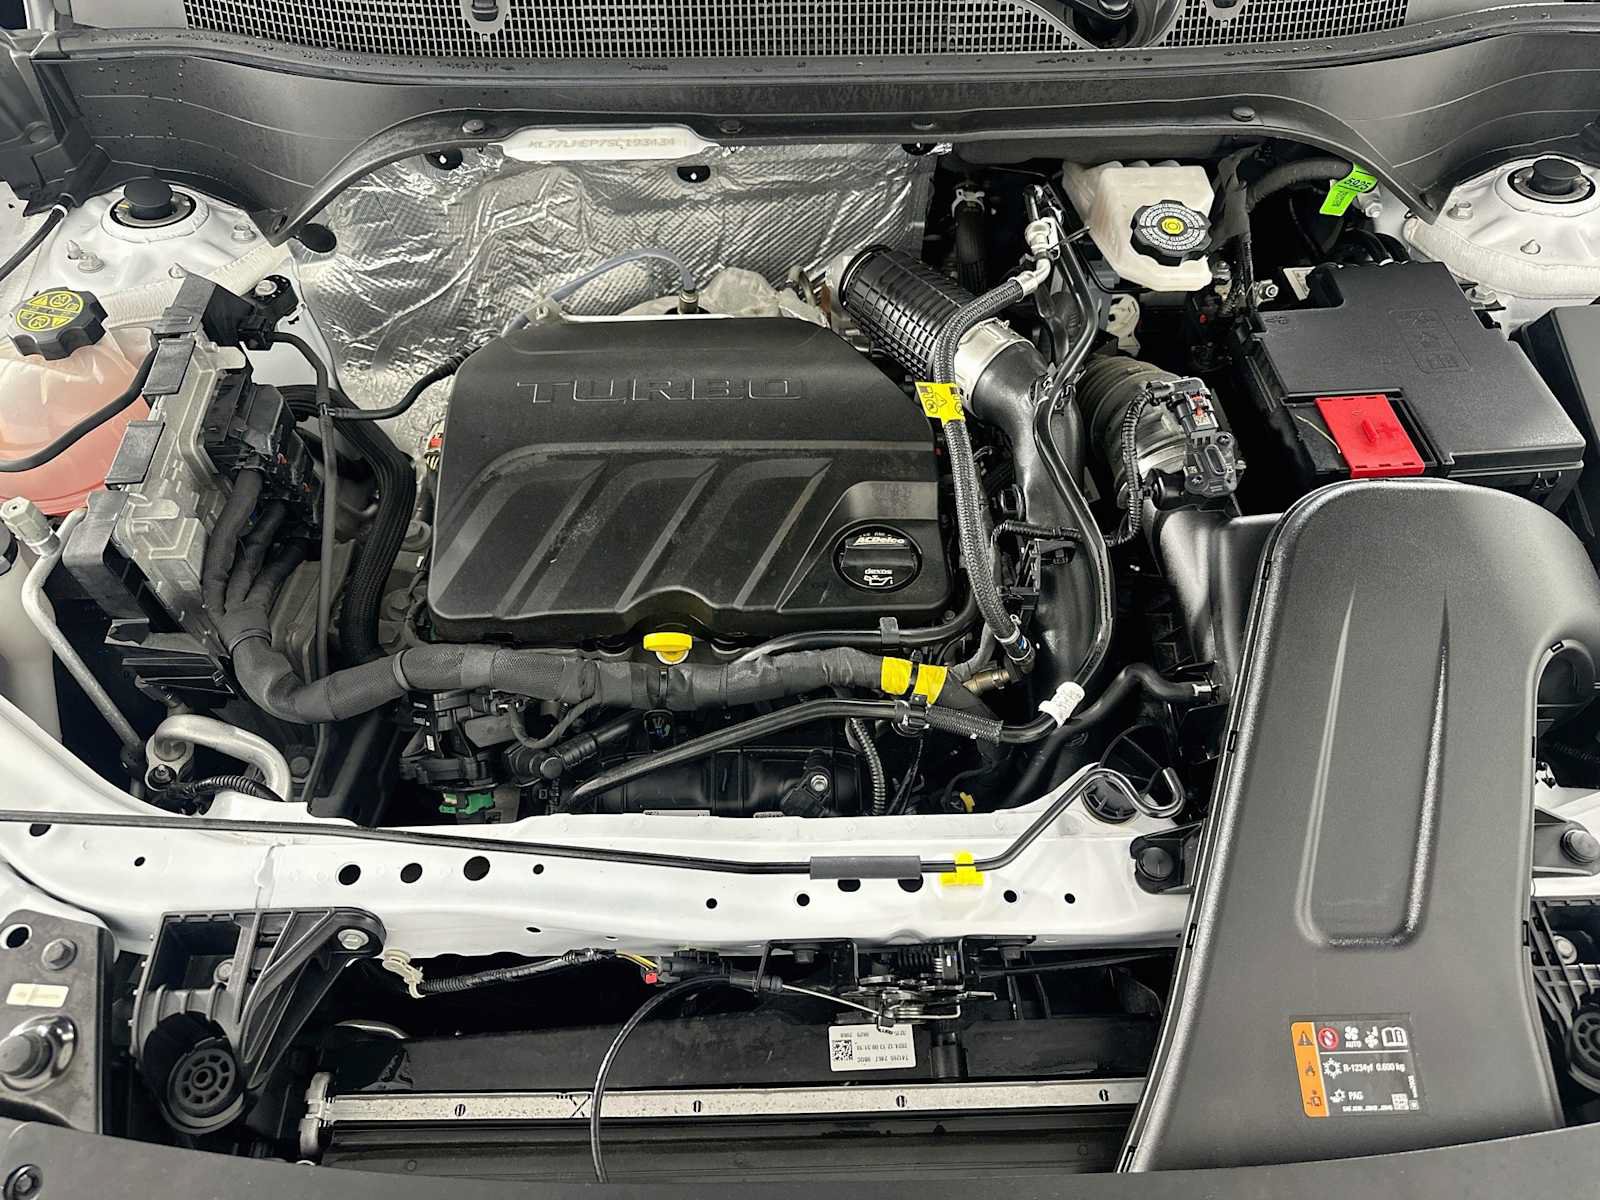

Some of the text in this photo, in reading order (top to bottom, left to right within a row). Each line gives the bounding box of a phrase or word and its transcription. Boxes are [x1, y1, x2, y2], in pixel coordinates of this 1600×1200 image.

[516, 378, 802, 403] TURBO
[1345, 1040, 1362, 1048] AUTO
[1348, 1091, 1364, 1101] PAG
